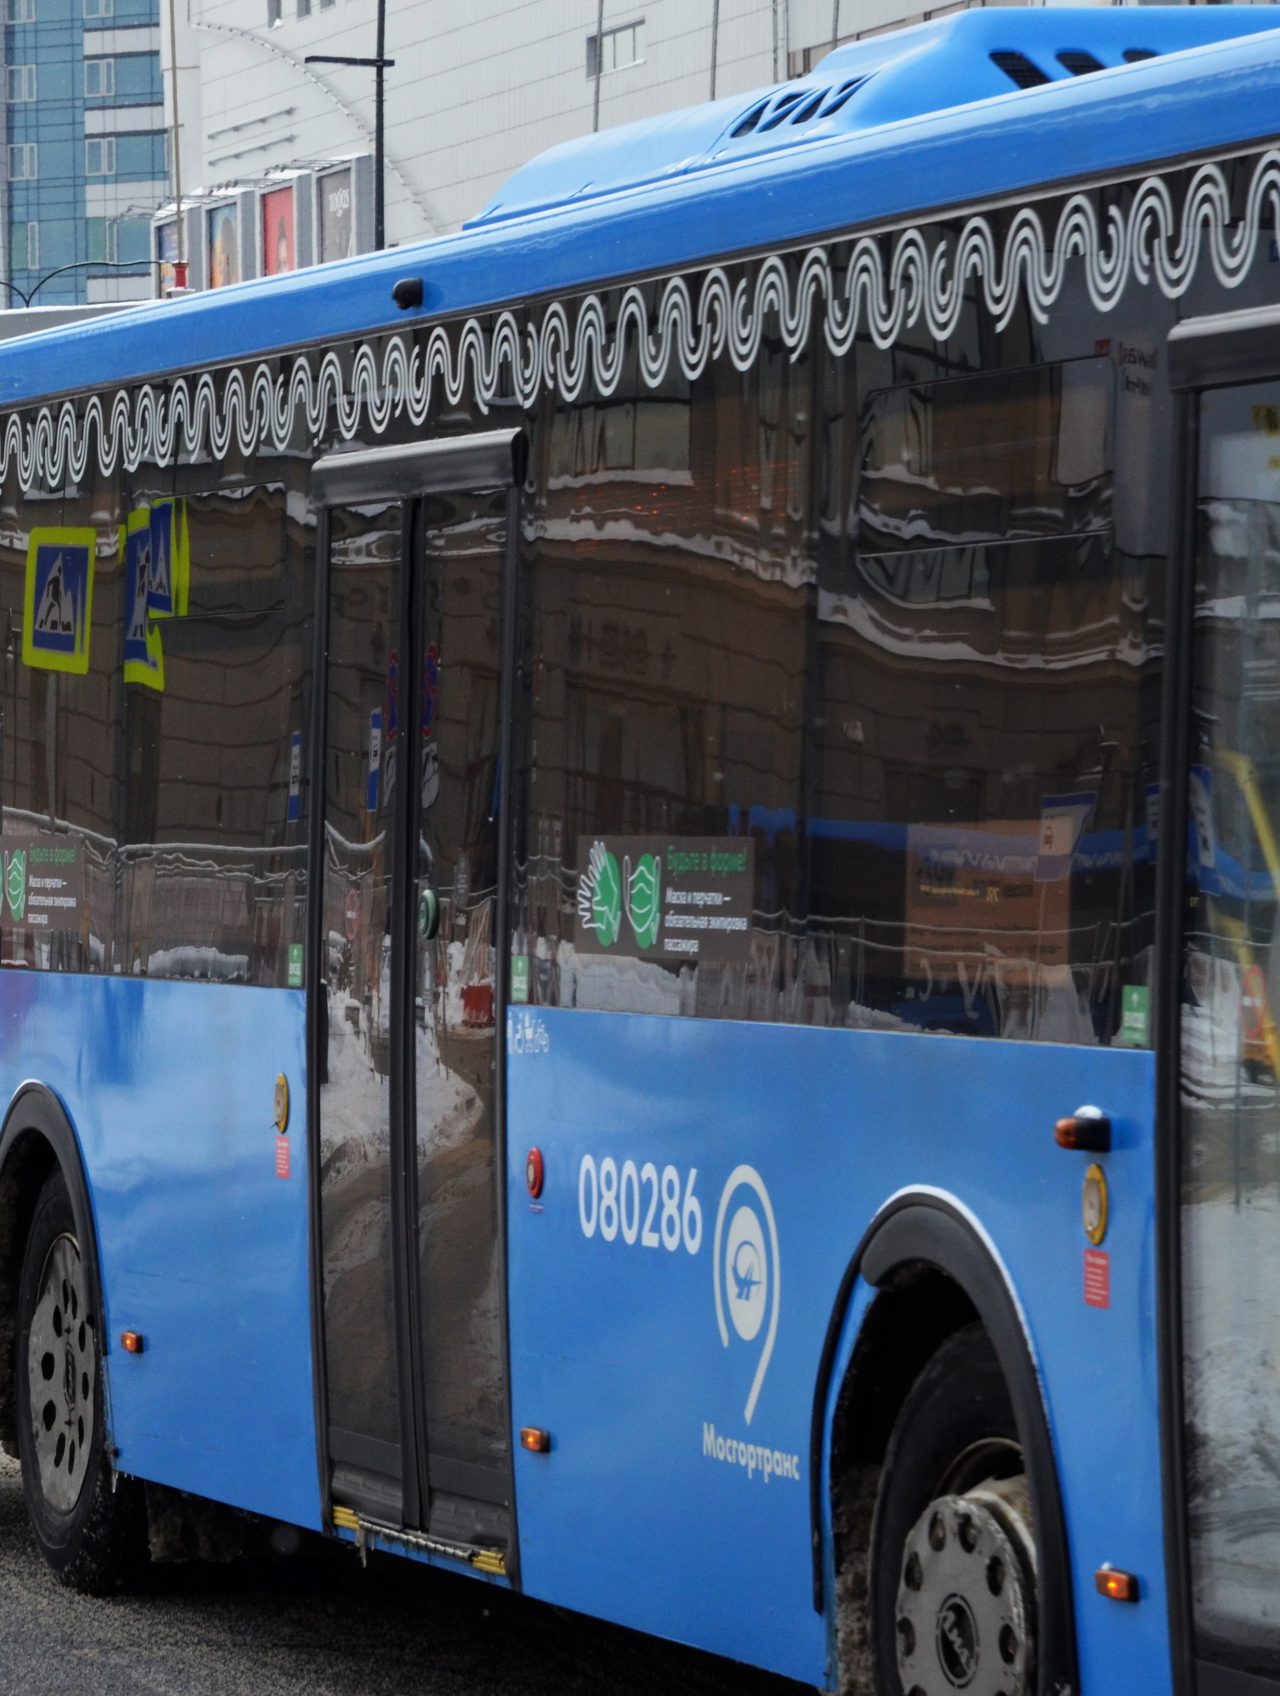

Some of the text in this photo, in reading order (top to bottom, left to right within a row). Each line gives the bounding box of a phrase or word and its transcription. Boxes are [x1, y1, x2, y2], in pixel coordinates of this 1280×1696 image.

[665, 887, 687, 904] Маска
[578, 1153, 703, 1256] 080286
[702, 1421, 801, 1484] Мосгортранс
